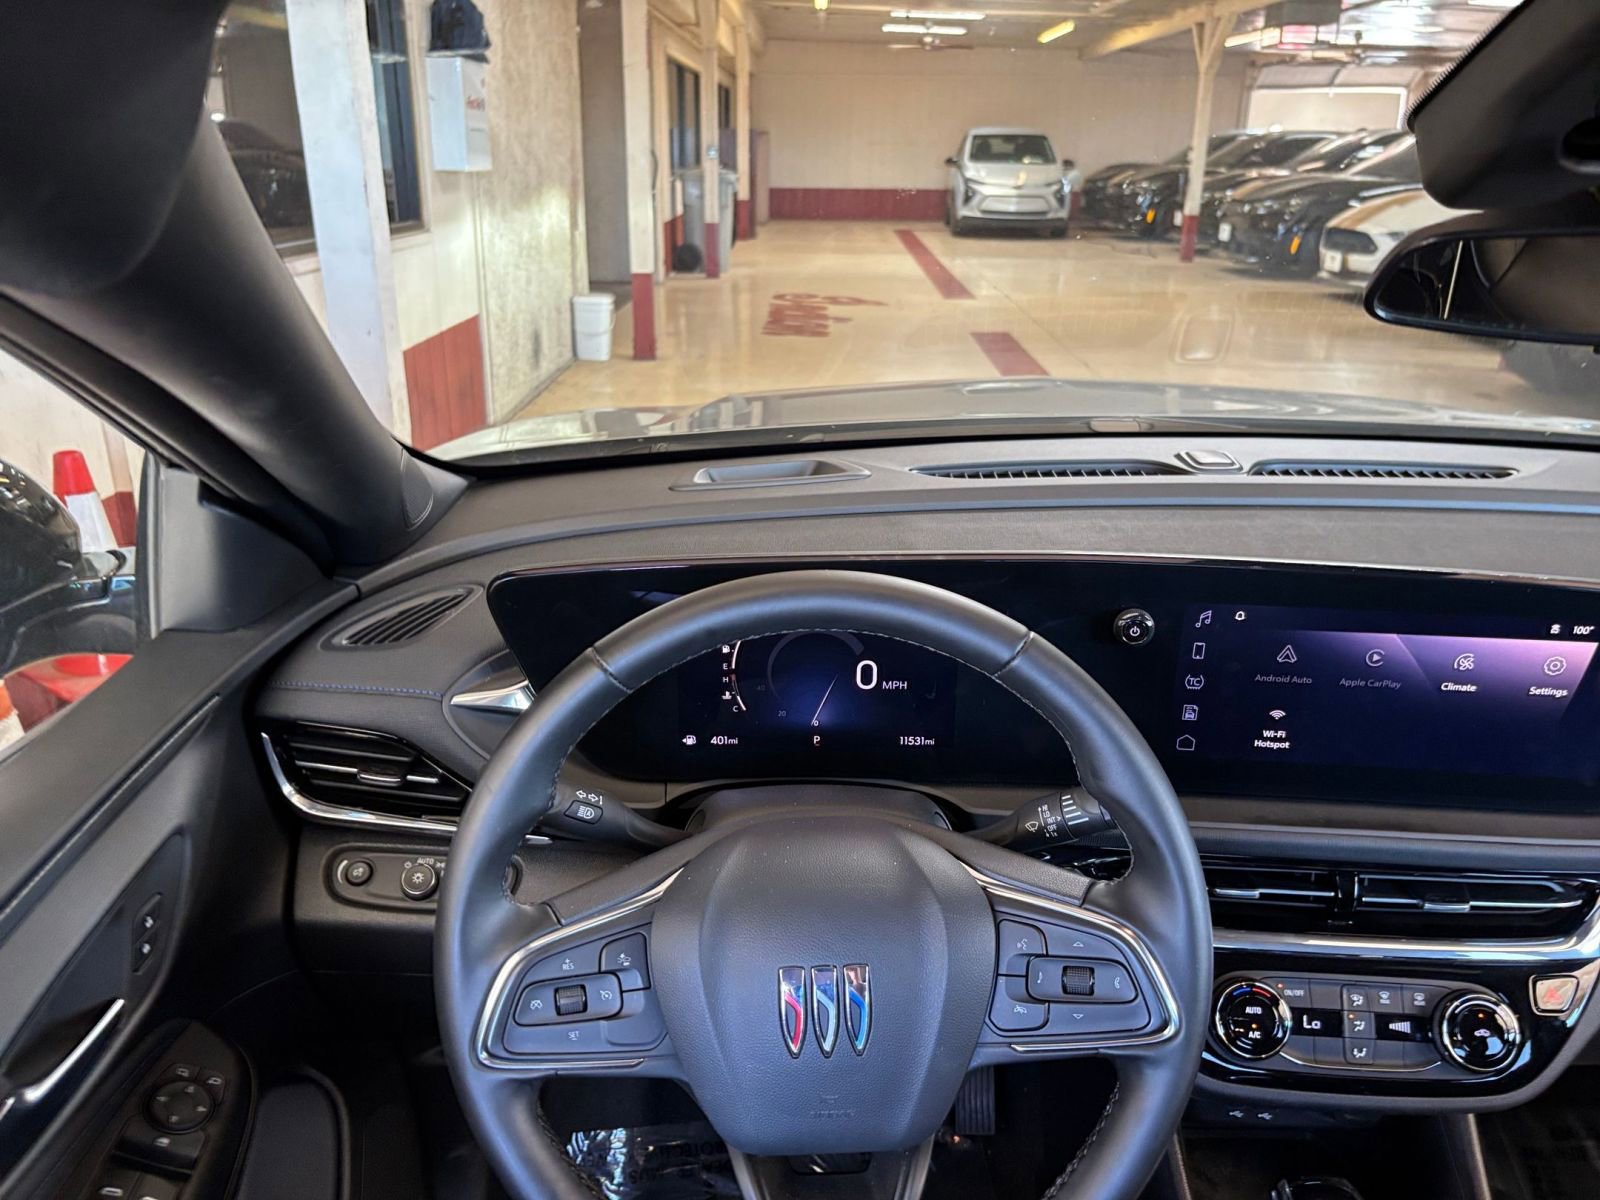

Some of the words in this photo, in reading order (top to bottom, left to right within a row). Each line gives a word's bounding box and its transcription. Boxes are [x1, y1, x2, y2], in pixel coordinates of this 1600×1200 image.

[722, 662, 729, 671] E
[856, 659, 878, 690] 0
[882, 680, 908, 690] MPH
[722, 676, 729, 684] H
[1254, 674, 1291, 684] Android
[1291, 675, 1313, 685] Auto
[1339, 677, 1366, 687] Apple
[1367, 678, 1402, 690] CarPlay
[1441, 682, 1478, 693] Climate
[1529, 686, 1569, 698] Settings
[733, 704, 739, 713] C
[777, 710, 787, 718] 20
[1262, 729, 1287, 739] Wi-Fi
[710, 735, 739, 745] 401mi
[813, 735, 821, 745] P
[1254, 739, 1290, 750] Hotspot
[416, 857, 435, 865] AUTO
[1283, 989, 1304, 997] ON/OFF
[1245, 1006, 1262, 1014] AUTO
[567, 1031, 580, 1039] SET
[1248, 1030, 1261, 1039] A/C
